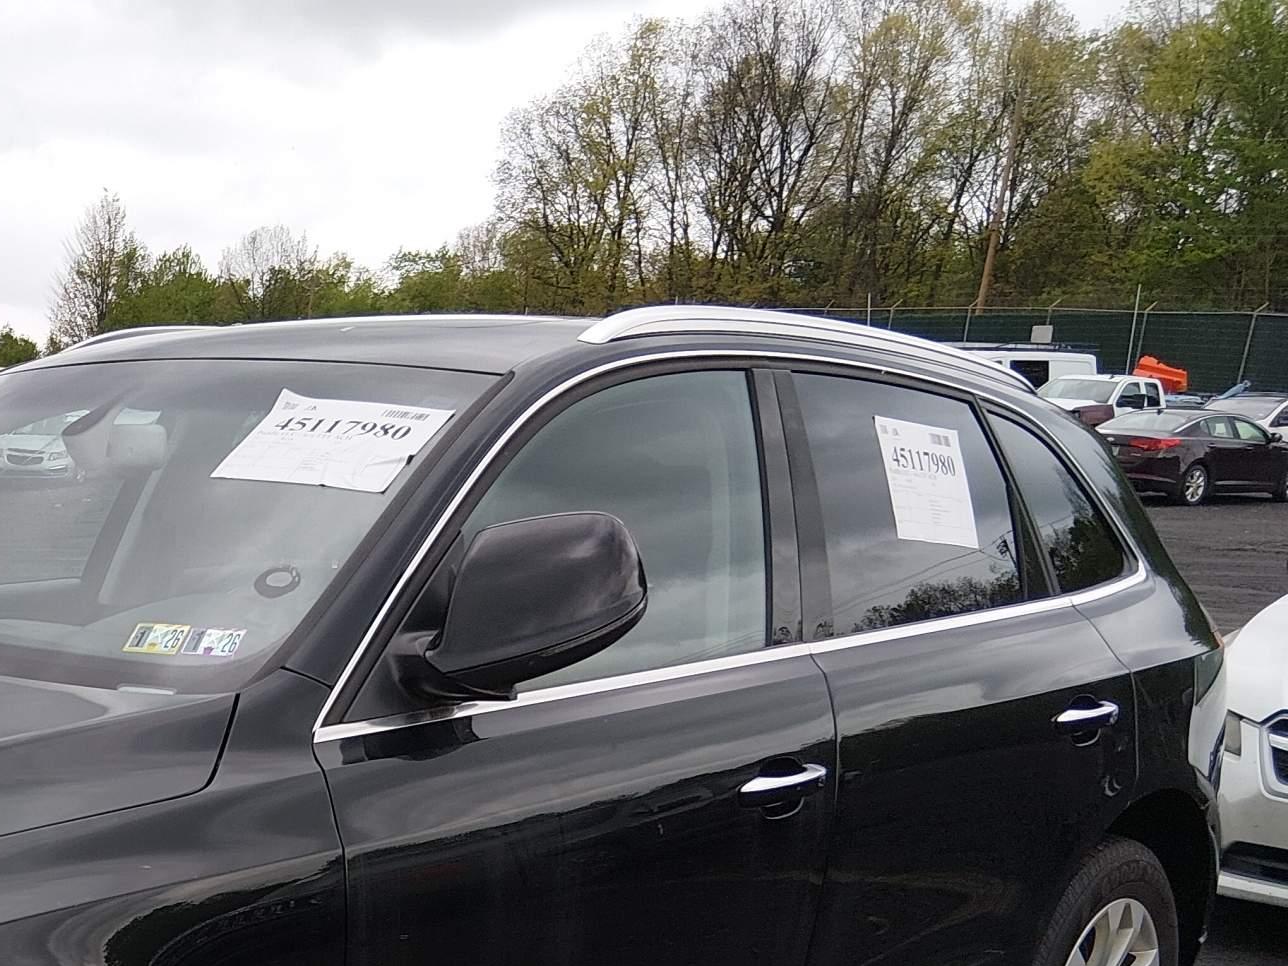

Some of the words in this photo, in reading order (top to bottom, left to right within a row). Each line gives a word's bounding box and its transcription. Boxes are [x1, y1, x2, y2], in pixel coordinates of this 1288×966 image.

[274, 416, 412, 441] 45117980
[892, 446, 956, 477] 45117980
[164, 629, 184, 649] 26
[221, 632, 240, 653] 26
